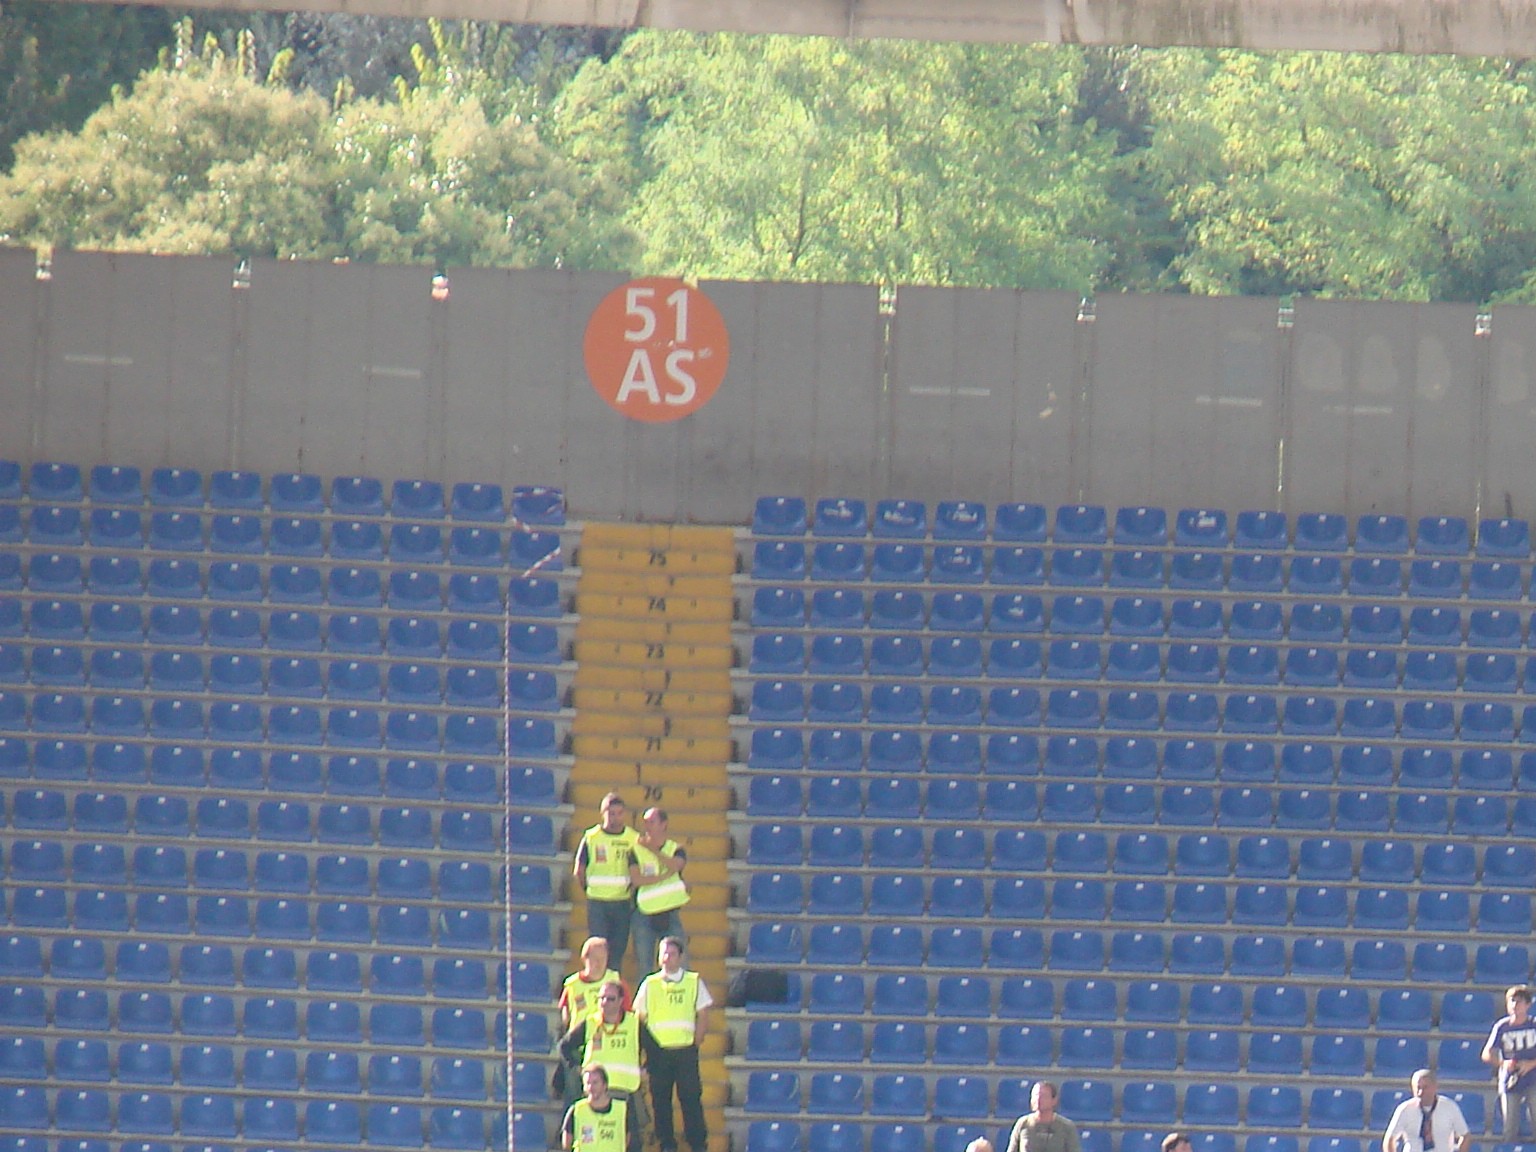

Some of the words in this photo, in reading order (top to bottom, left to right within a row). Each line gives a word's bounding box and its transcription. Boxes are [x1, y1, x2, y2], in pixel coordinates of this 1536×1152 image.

[623, 287, 688, 343] 51
[615, 348, 696, 405] AS
[644, 784, 663, 801] 70
